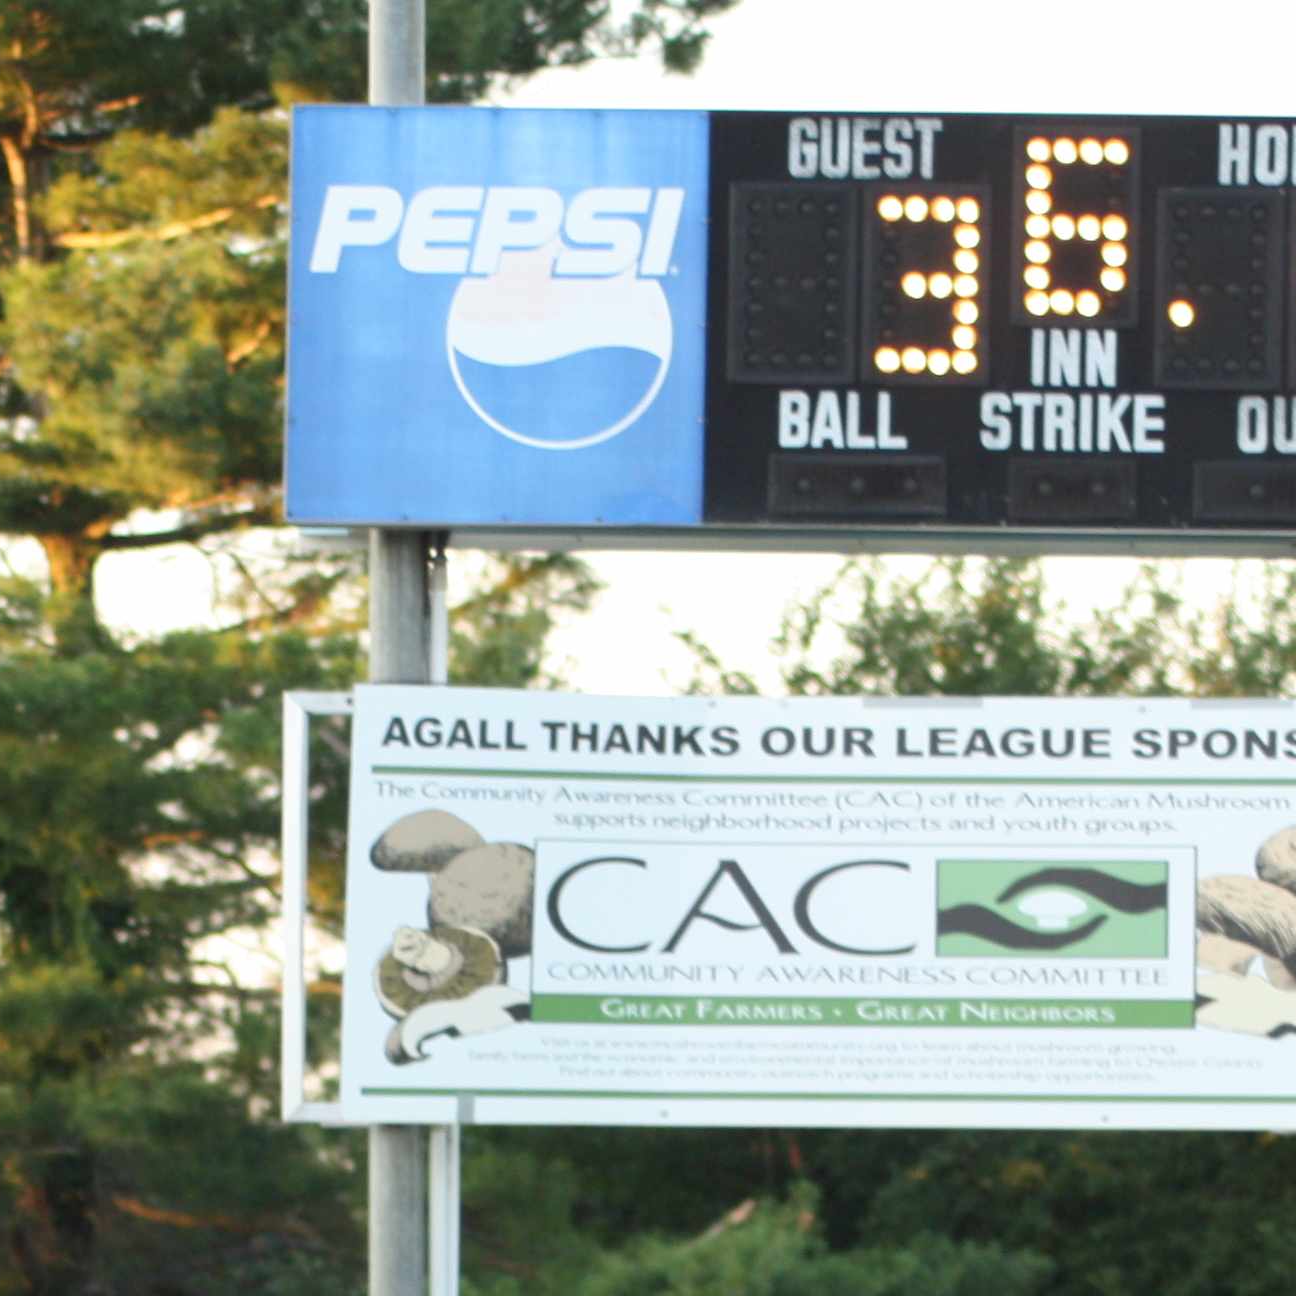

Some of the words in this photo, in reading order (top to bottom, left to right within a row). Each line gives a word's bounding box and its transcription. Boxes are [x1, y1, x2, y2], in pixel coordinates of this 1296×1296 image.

[788, 117, 943, 180] GUEST
[309, 184, 686, 278] PEPSI
[1024, 136, 1129, 317] 6
[874, 194, 981, 376] 3
[1031, 327, 1118, 388] INN
[777, 389, 908, 450] BALL
[979, 392, 1166, 453] STRIKE
[381, 716, 527, 750] AGALL
[541, 721, 740, 756] THANKS
[760, 726, 877, 757] OUR
[896, 727, 1112, 759] LEAGUE
[376, 781, 415, 798] The
[422, 783, 546, 805] Community
[554, 786, 677, 806] Awareness
[683, 788, 827, 808] Committee
[930, 790, 961, 809] of
[965, 790, 1004, 810] the
[1016, 791, 1140, 811] American
[1147, 791, 1292, 812] Mushroom
[554, 812, 648, 832] supports
[653, 813, 832, 834] neighborhood
[838, 815, 942, 837] projects
[947, 815, 996, 832] and
[1003, 815, 1078, 836] youth
[546, 856, 918, 956] CAC
[547, 961, 744, 984] COMMUNITY
[756, 964, 957, 986] AWARENESS
[965, 966, 1169, 988] COMMITTEE
[600, 998, 688, 1021] GREAT
[695, 999, 823, 1023] FARMERS
[856, 1001, 952, 1024] GREAT
[959, 1000, 1117, 1026] NEIGHBORS
